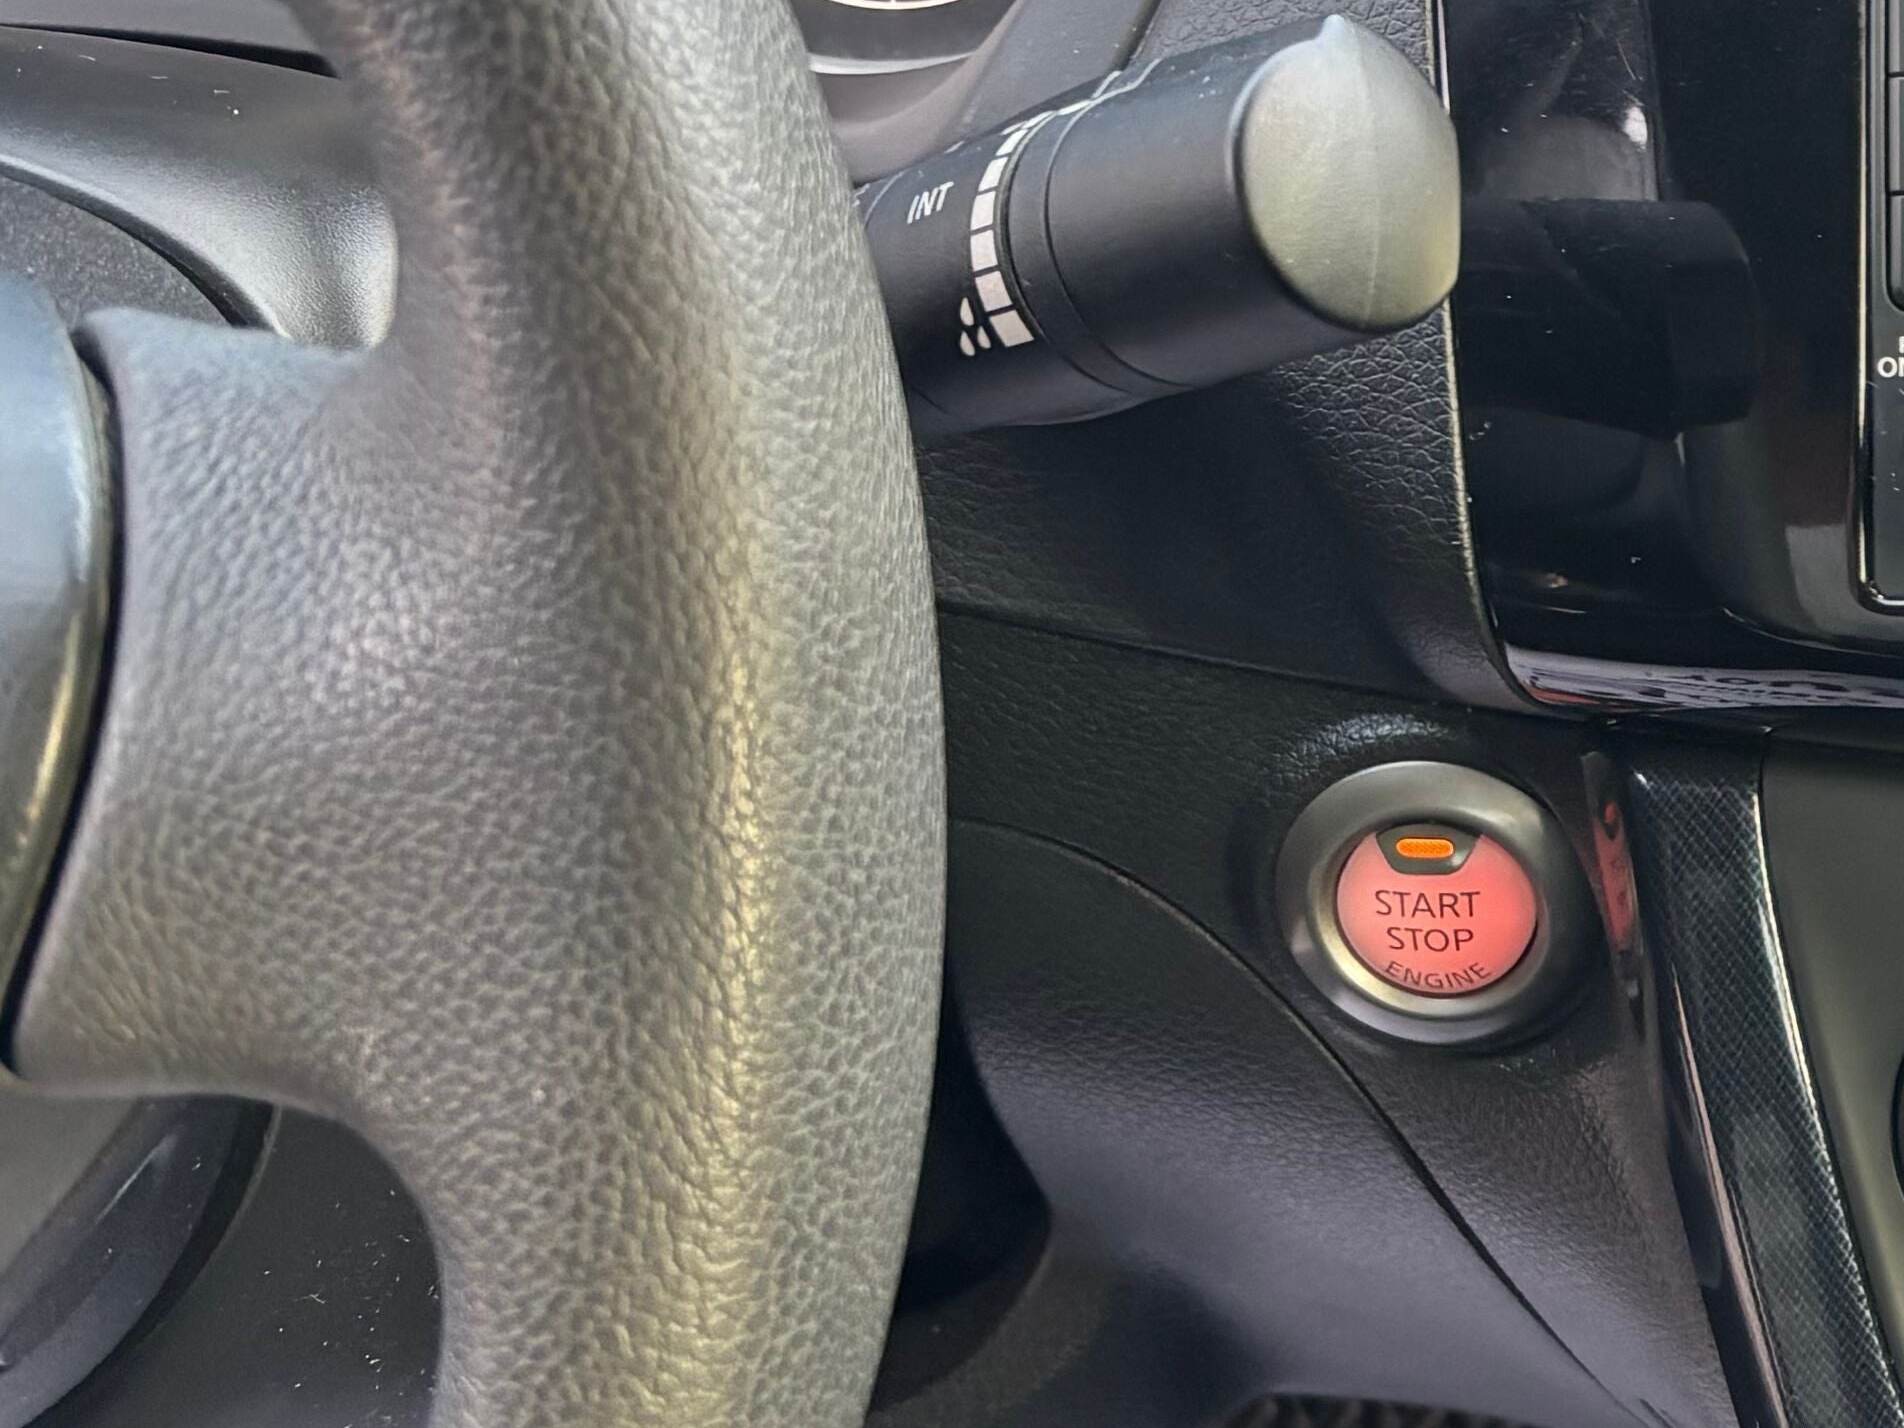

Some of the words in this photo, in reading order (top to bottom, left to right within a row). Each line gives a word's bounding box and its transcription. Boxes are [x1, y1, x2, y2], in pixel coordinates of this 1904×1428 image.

[907, 181, 954, 224] INT
[1375, 889, 1480, 918] START
[1387, 927, 1474, 952] STOP
[1385, 961, 1492, 991] ENGINE
